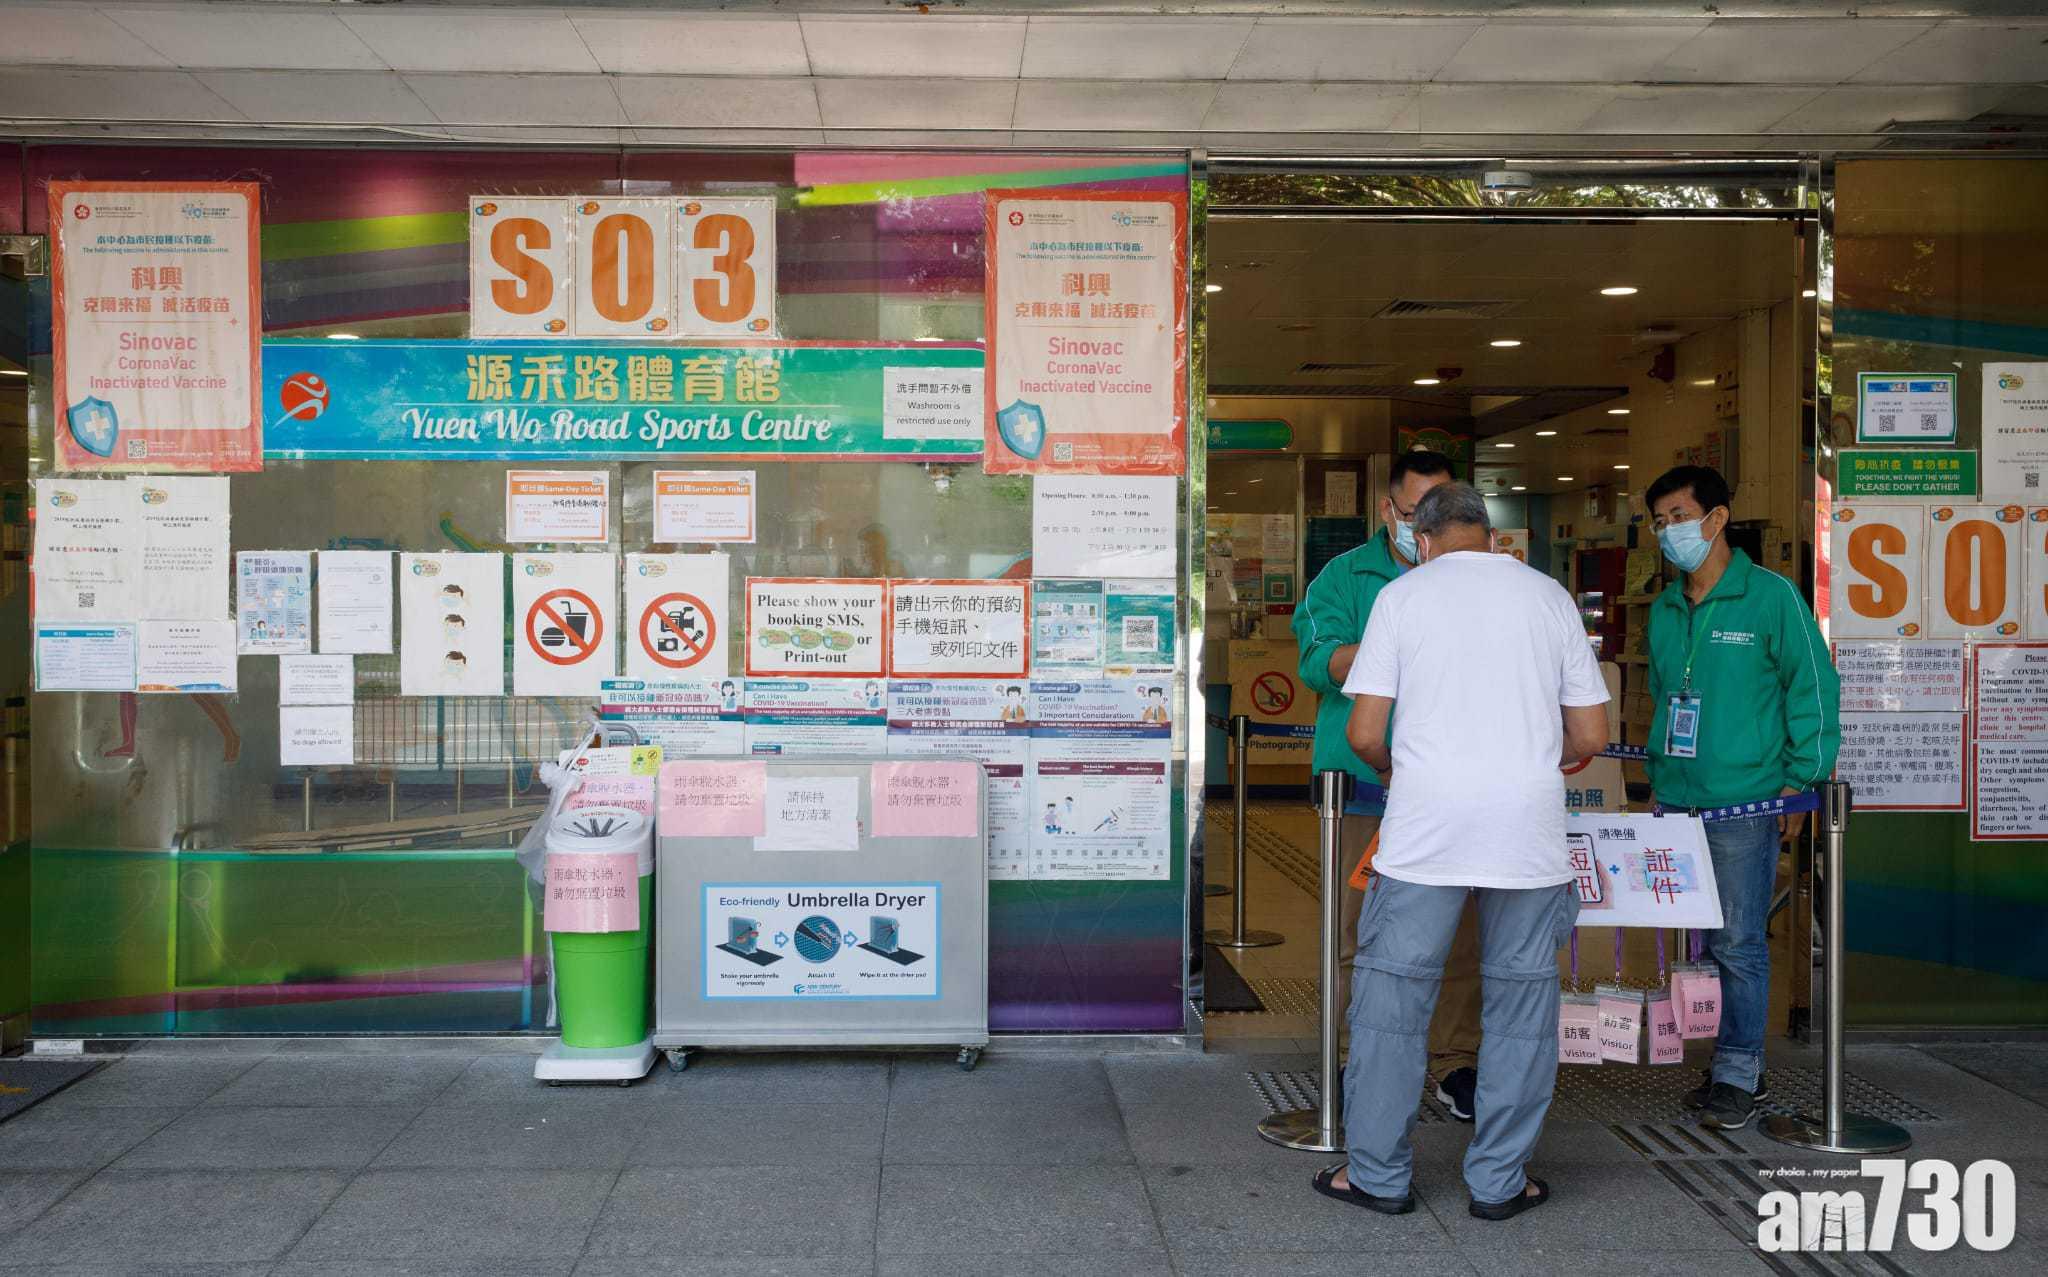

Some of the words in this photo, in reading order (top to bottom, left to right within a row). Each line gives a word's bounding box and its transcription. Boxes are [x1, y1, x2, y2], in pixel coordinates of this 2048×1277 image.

[490, 213, 755, 323] S03
[131, 266, 183, 290] 科興
[1061, 272, 1111, 297] 科興
[83, 297, 151, 312] 克爾來福
[1015, 302, 1081, 318] 克爾來福
[120, 333, 197, 350] Sinovac
[1048, 337, 1123, 356] Sinovac
[118, 357, 196, 370] CoronaVac
[1047, 361, 1121, 375] CoronaVac
[90, 376, 169, 389] Inactivated
[174, 376, 227, 389] Vaccine
[466, 354, 782, 402] 源禾路體育館
[896, 383, 972, 394] 洗手間暫不外借
[1020, 380, 1095, 394] Inactivated
[1099, 380, 1152, 394] Vaccine
[907, 401, 951, 410] Washroom
[954, 402, 960, 410] is
[401, 408, 480, 440] Yuen
[486, 407, 546, 440] Wo
[549, 408, 631, 440] Road
[639, 407, 733, 449] Sports
[741, 408, 832, 441] Centre
[896, 415, 935, 426] restricted
[937, 418, 952, 426] use
[953, 416, 971, 427] only
[1856, 483, 1892, 491] PLEASE
[1893, 483, 1920, 491] DON'T
[1923, 483, 1960, 491] GATHER
[1848, 520, 2048, 627] S0
[757, 595, 800, 607] Please
[804, 595, 837, 607] show
[844, 598, 876, 611] your
[896, 595, 1022, 612] 請出示你的預約
[768, 613, 823, 627] booking
[857, 637, 873, 645] or
[784, 650, 848, 663] Print-out
[930, 641, 1018, 658] 或列印文件
[1838, 649, 1857, 657] 2019
[1250, 740, 1310, 751] Photography
[787, 791, 824, 804] 請保持
[1564, 789, 1604, 808] 拍照
[782, 809, 831, 821] 地方清潔
[1599, 829, 1637, 841] 請準備
[553, 886, 626, 900] 請勿棄置垃圾
[719, 897, 780, 909] Eco-friendly
[787, 893, 869, 907] Umbrella
[875, 893, 926, 910] Dryer
[1692, 1001, 1715, 1014] 訪客
[1603, 1016, 1632, 1031] 訪客
[1688, 1023, 1714, 1033] Visitor
[1564, 1027, 1591, 1040] 訪客
[1600, 1038, 1633, 1050] Visitor
[1564, 1049, 1596, 1059] Visitor
[1656, 1046, 1679, 1057] Visitor
